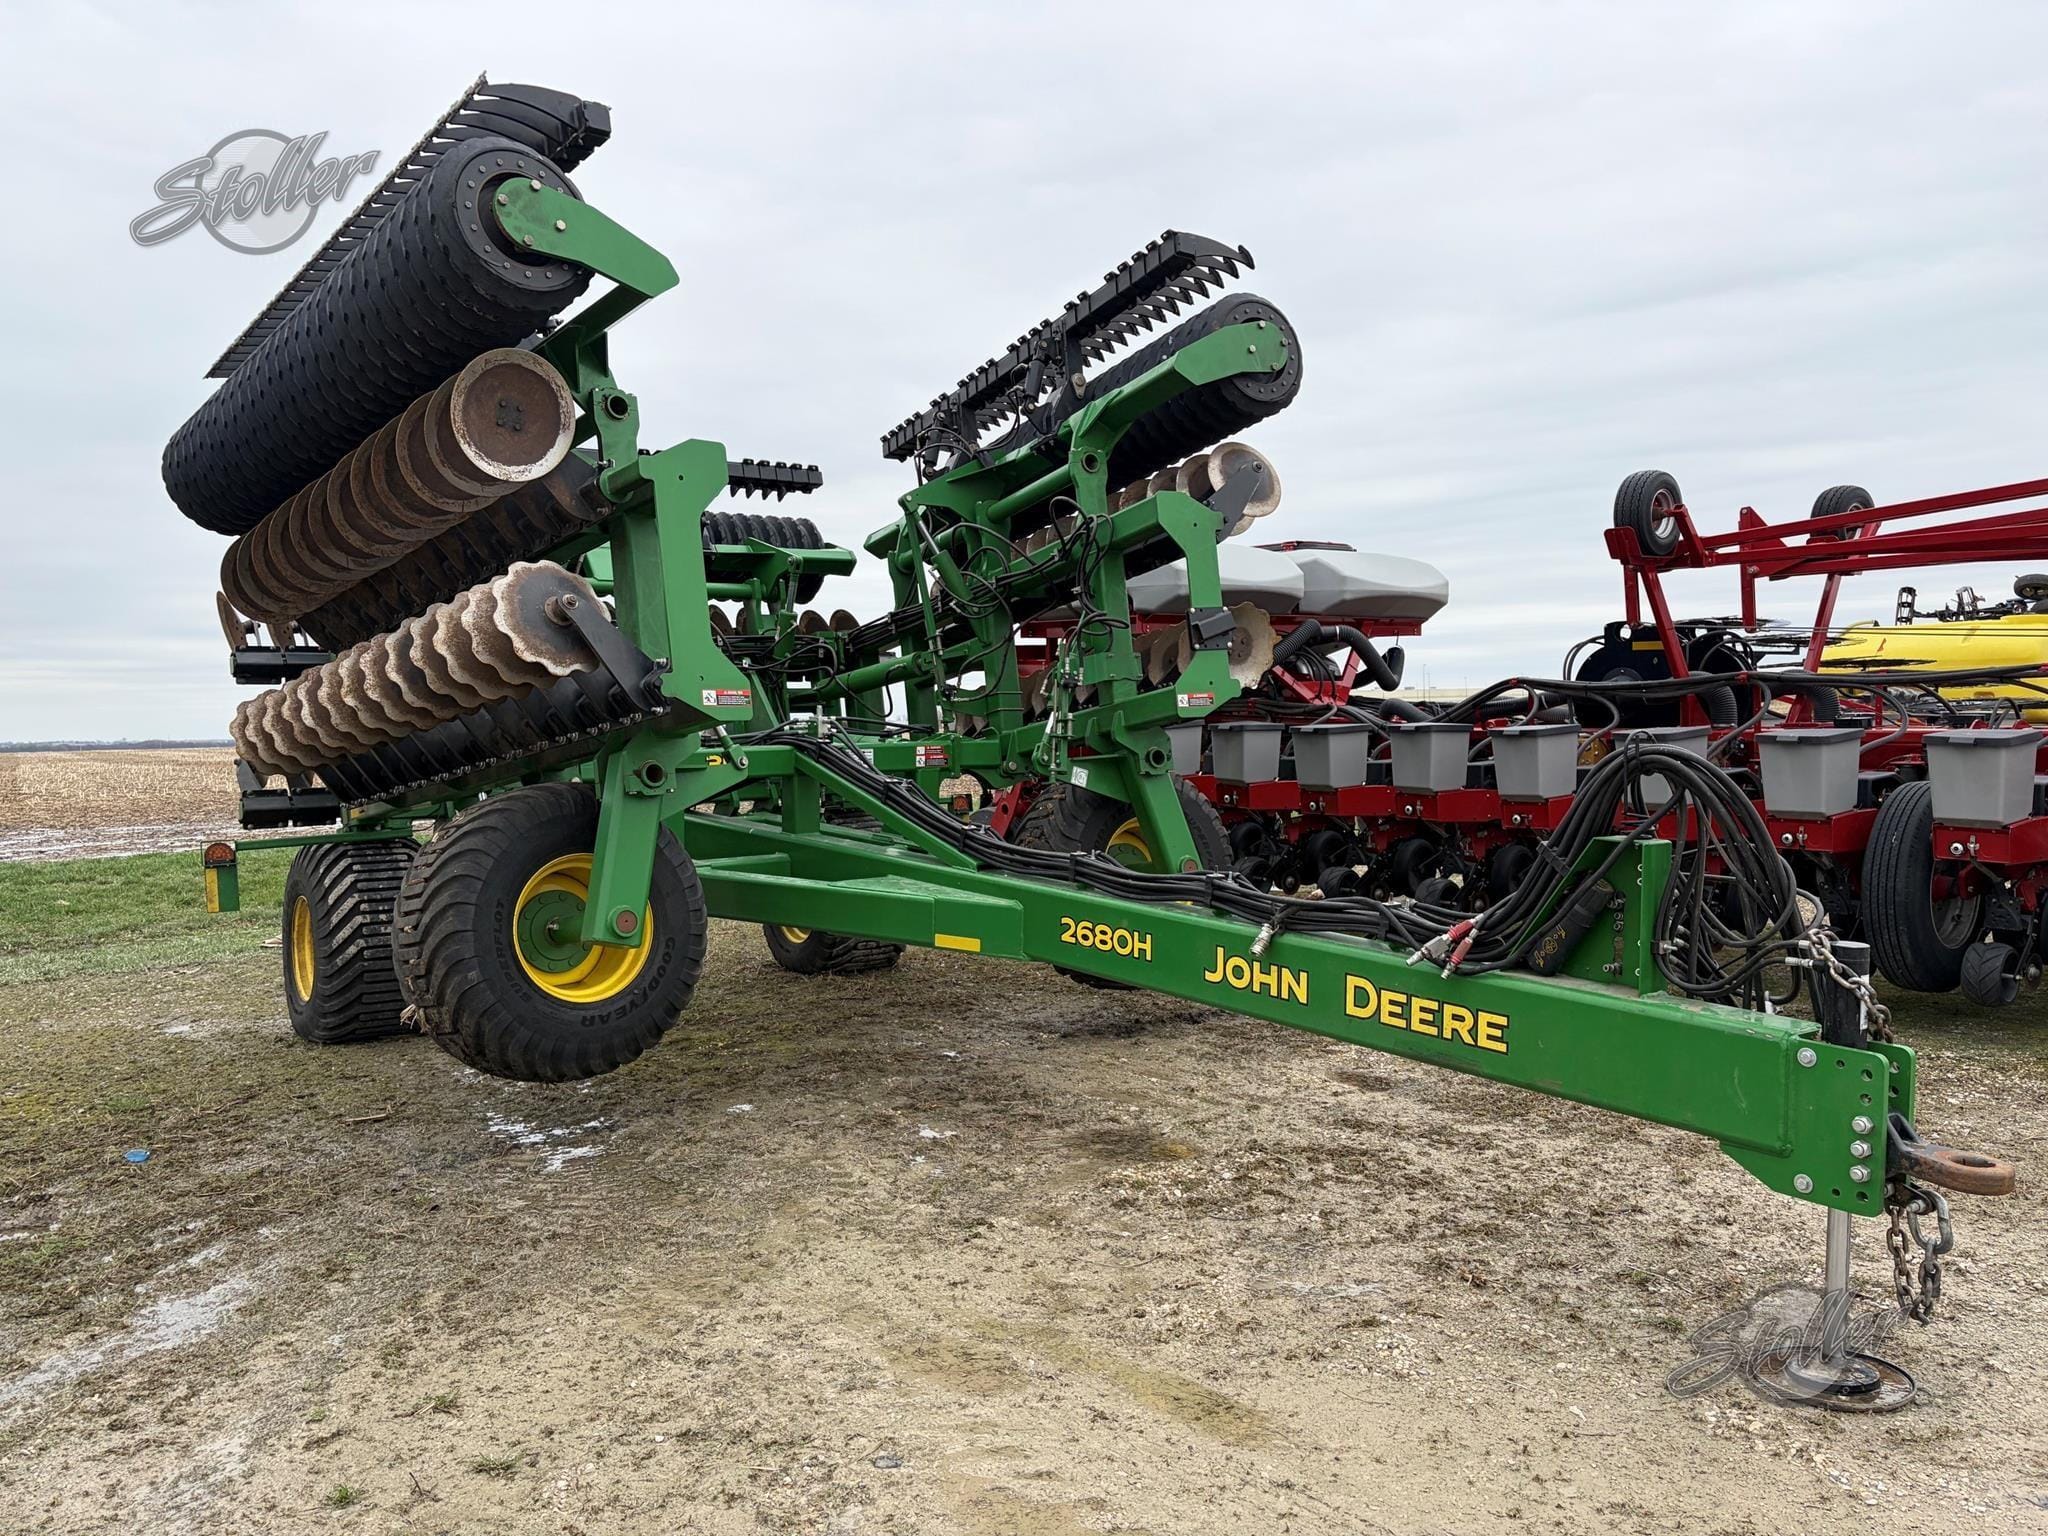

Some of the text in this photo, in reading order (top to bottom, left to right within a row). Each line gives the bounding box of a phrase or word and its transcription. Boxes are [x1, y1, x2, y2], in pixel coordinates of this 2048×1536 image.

[580, 937, 676, 1028] GOODYEAR
[1061, 917, 1152, 962] 2680H
[1204, 945, 1509, 1053] JOHN DEERE
